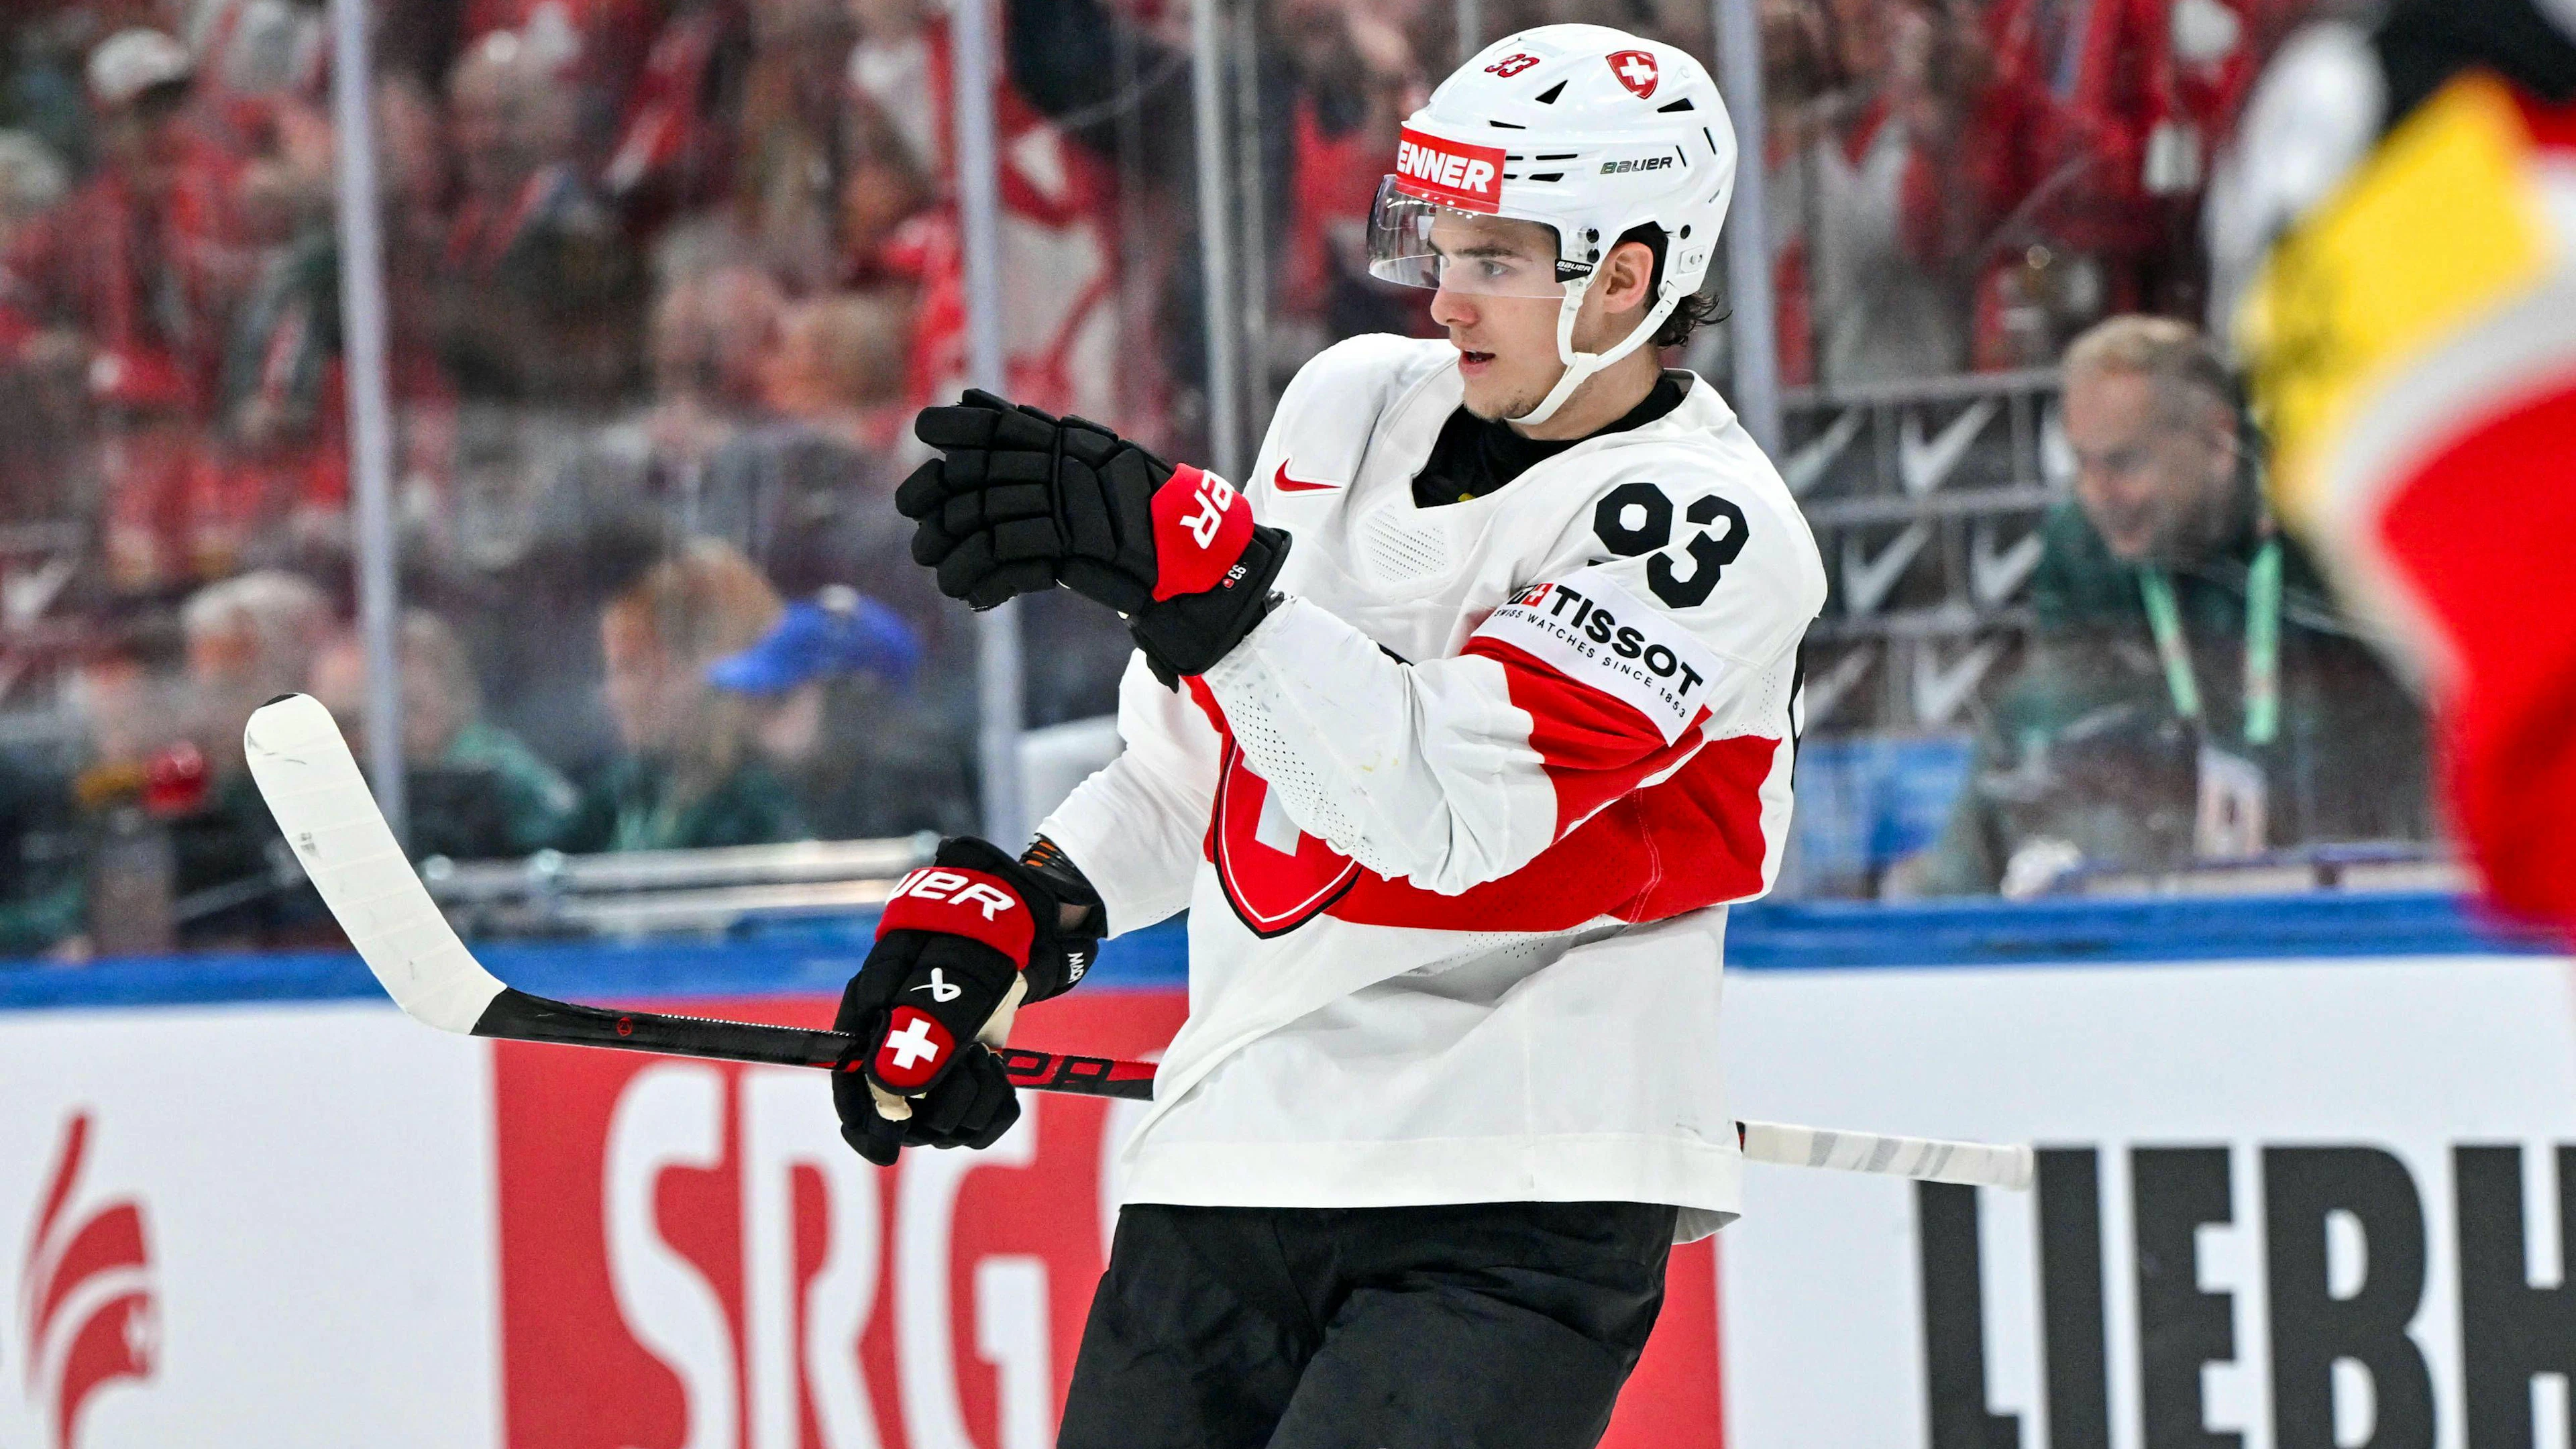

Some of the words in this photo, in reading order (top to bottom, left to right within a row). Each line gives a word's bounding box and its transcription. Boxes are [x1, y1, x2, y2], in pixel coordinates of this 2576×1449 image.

[1396, 140, 1495, 193] ENNER
[1600, 156, 1672, 174] BAUER
[1556, 260, 1592, 272] BAUER
[1228, 564, 1247, 580] 93
[1587, 482, 1750, 609] 93
[1494, 609, 1523, 618] SWISS
[1527, 613, 1595, 658] WATCHES
[1603, 657, 1653, 688] SINCE
[1660, 688, 1686, 718] 1853
[1550, 584, 1703, 697] TISSOT
[600, 1061, 1051, 1449] SRG
